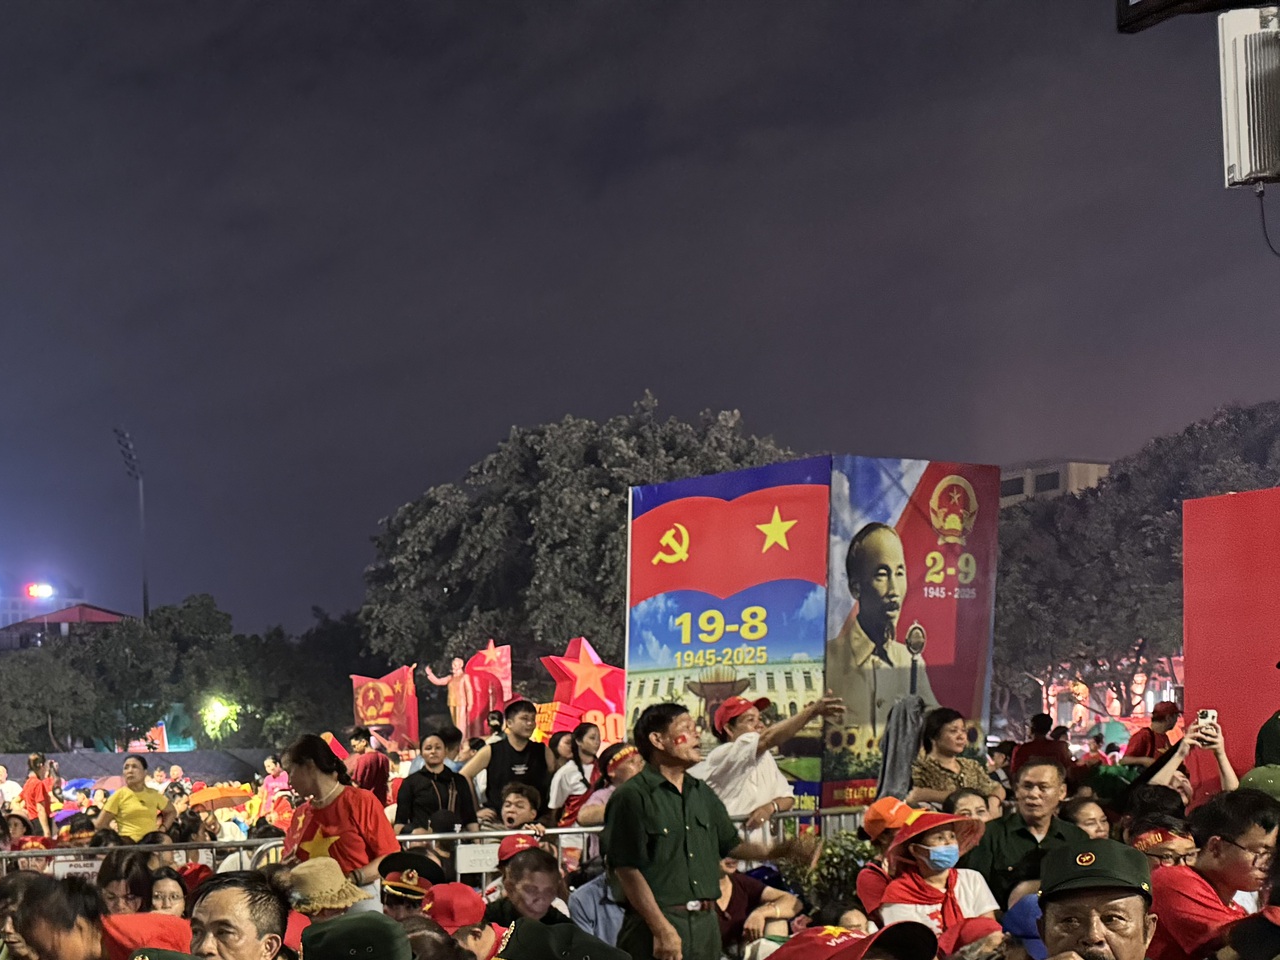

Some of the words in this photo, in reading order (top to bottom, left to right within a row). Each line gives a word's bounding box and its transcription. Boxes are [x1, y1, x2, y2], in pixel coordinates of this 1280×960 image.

[925, 551, 977, 584] 2-9
[923, 586, 946, 598] 1945
[675, 605, 768, 645] 19-8
[674, 646, 768, 669] 1945-2025
